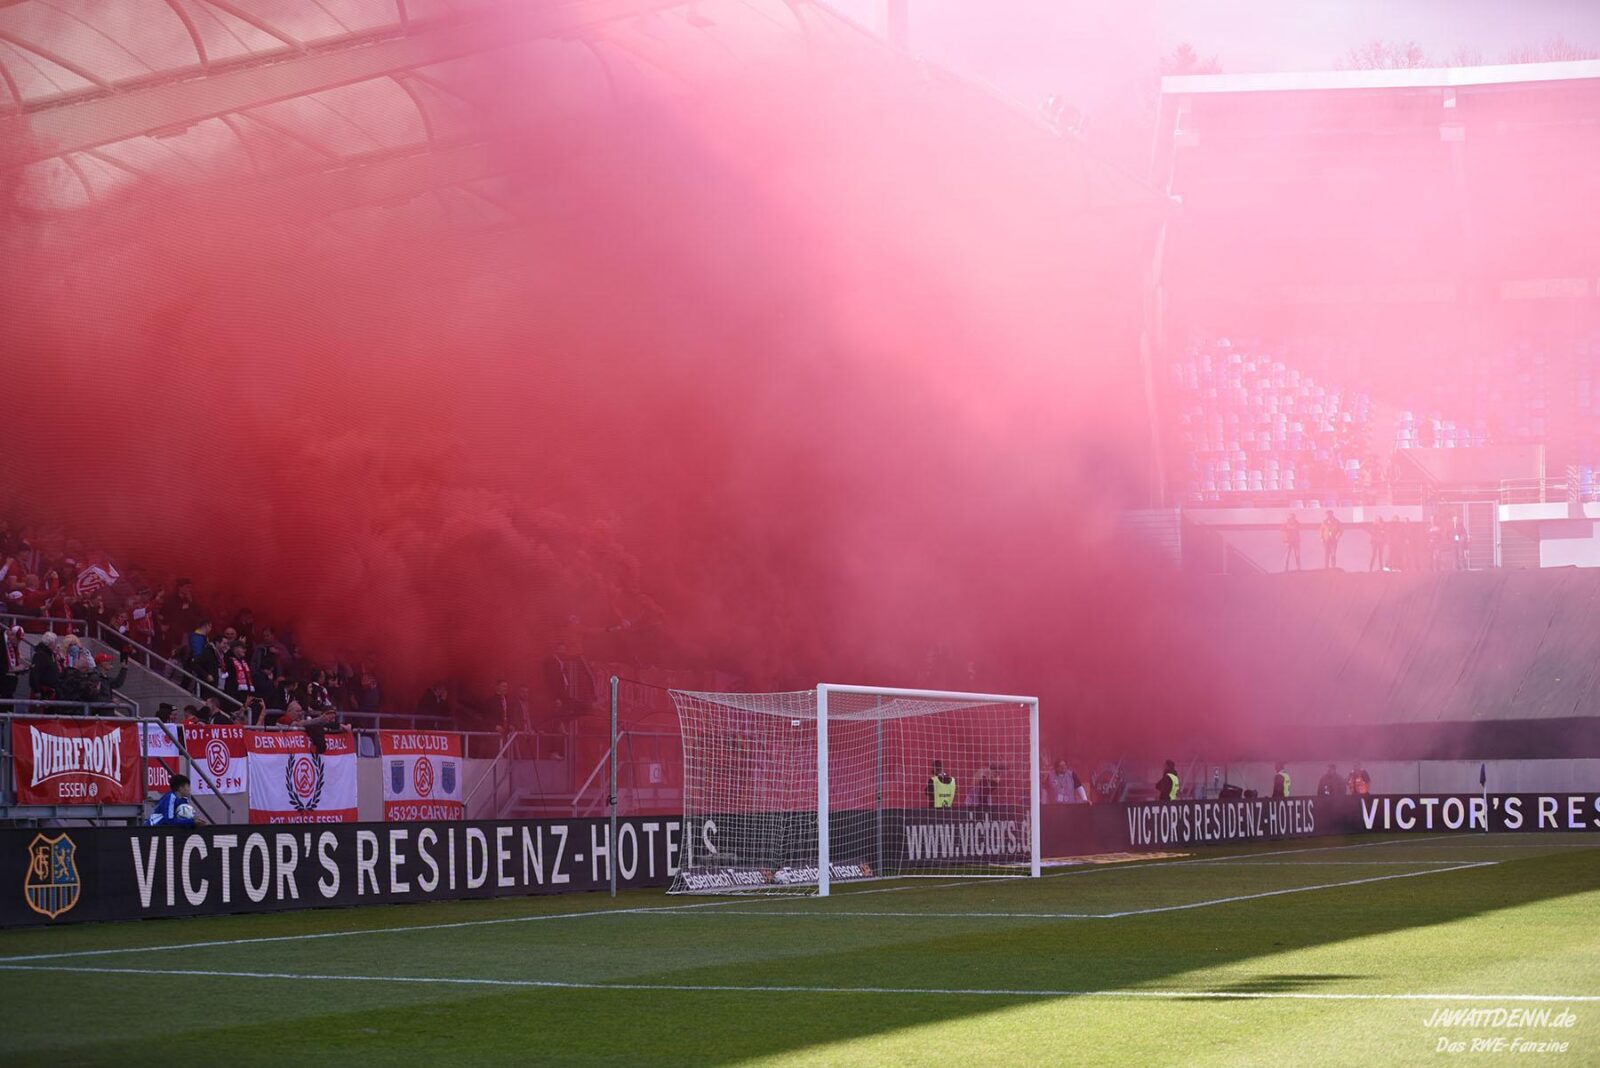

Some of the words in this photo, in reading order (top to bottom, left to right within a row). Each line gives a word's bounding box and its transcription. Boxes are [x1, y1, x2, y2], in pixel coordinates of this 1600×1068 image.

[184, 728, 243, 740] ROT-WEISS
[254, 736, 276, 748] DER
[275, 736, 305, 748] WAHRE
[391, 735, 449, 751] FANCLUB
[30, 725, 121, 787] RUHRFRONT
[59, 783, 87, 797] ESSEN
[198, 778, 241, 789] ESSEN
[1128, 804, 1190, 845] VICTOR'S
[1195, 800, 1315, 841] RESIDENZ-HOTELS
[1361, 797, 1524, 830] VICTOR'S
[906, 810, 1031, 860] www.victors.d
[130, 830, 340, 907] VICTOR'S
[356, 820, 718, 896] RESIDENZ-HOTELS
[682, 868, 736, 890] Eisenbach
